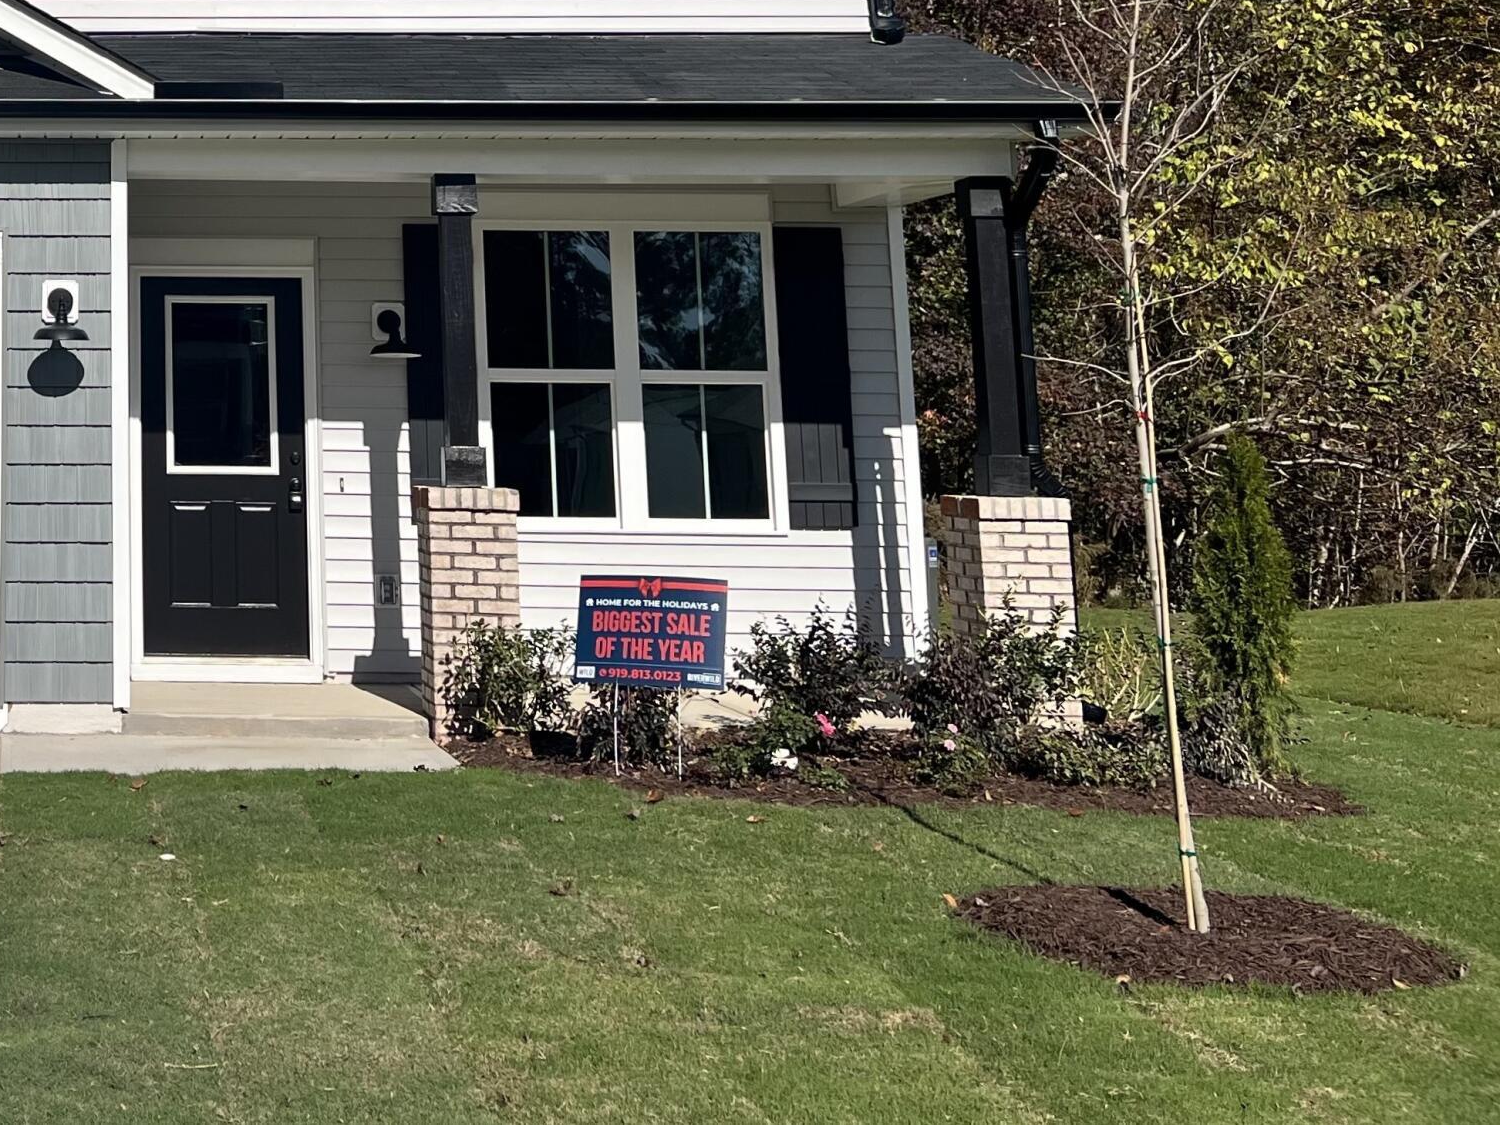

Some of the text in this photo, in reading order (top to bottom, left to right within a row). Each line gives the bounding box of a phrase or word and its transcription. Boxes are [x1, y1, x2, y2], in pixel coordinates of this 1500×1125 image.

[596, 599, 708, 610] HOME FOR THE HOLIDAYS
[592, 611, 711, 637] BIGGEST SALE
[595, 637, 705, 663] OF THE YEAR
[608, 668, 681, 682] 919.813.0123
